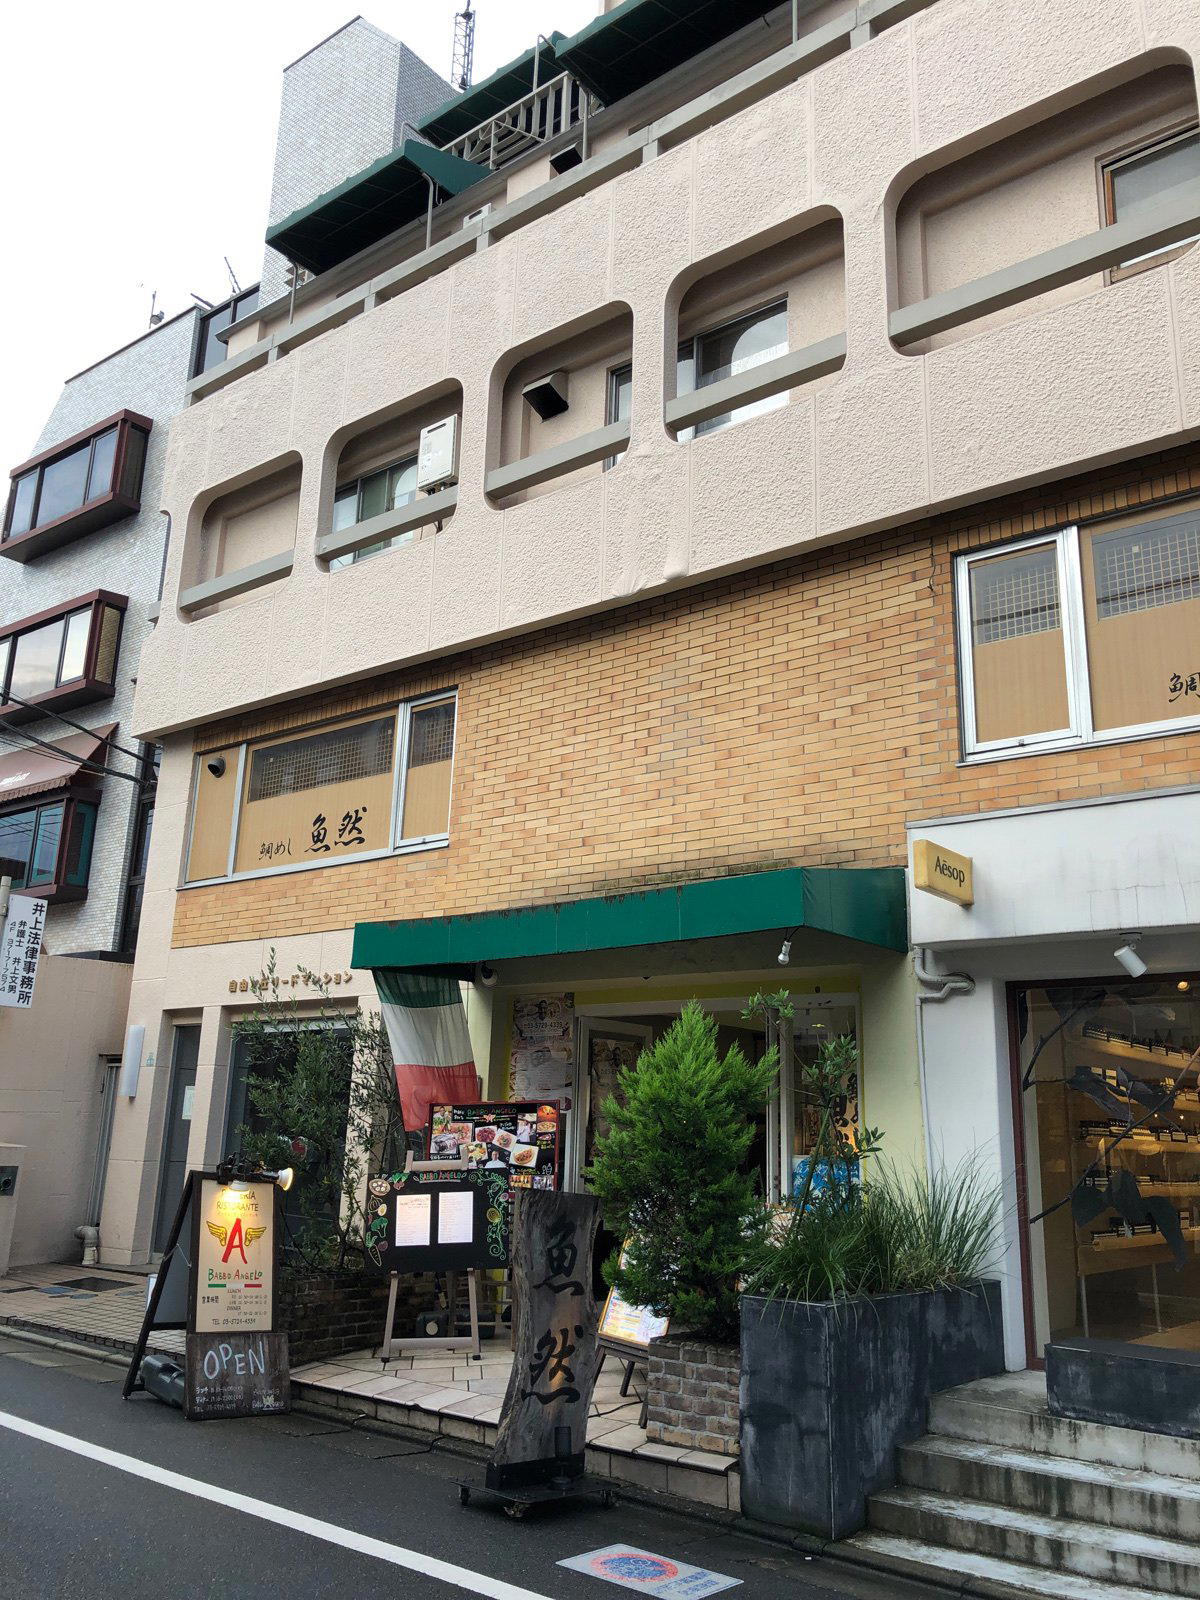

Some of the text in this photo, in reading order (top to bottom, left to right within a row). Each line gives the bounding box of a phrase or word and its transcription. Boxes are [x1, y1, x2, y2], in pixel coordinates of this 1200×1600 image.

[7, 919, 28, 995] 弁護士 井上文男
[16, 902, 46, 1006] 井上法律事務所
[203, 1340, 266, 1380] OPEN
